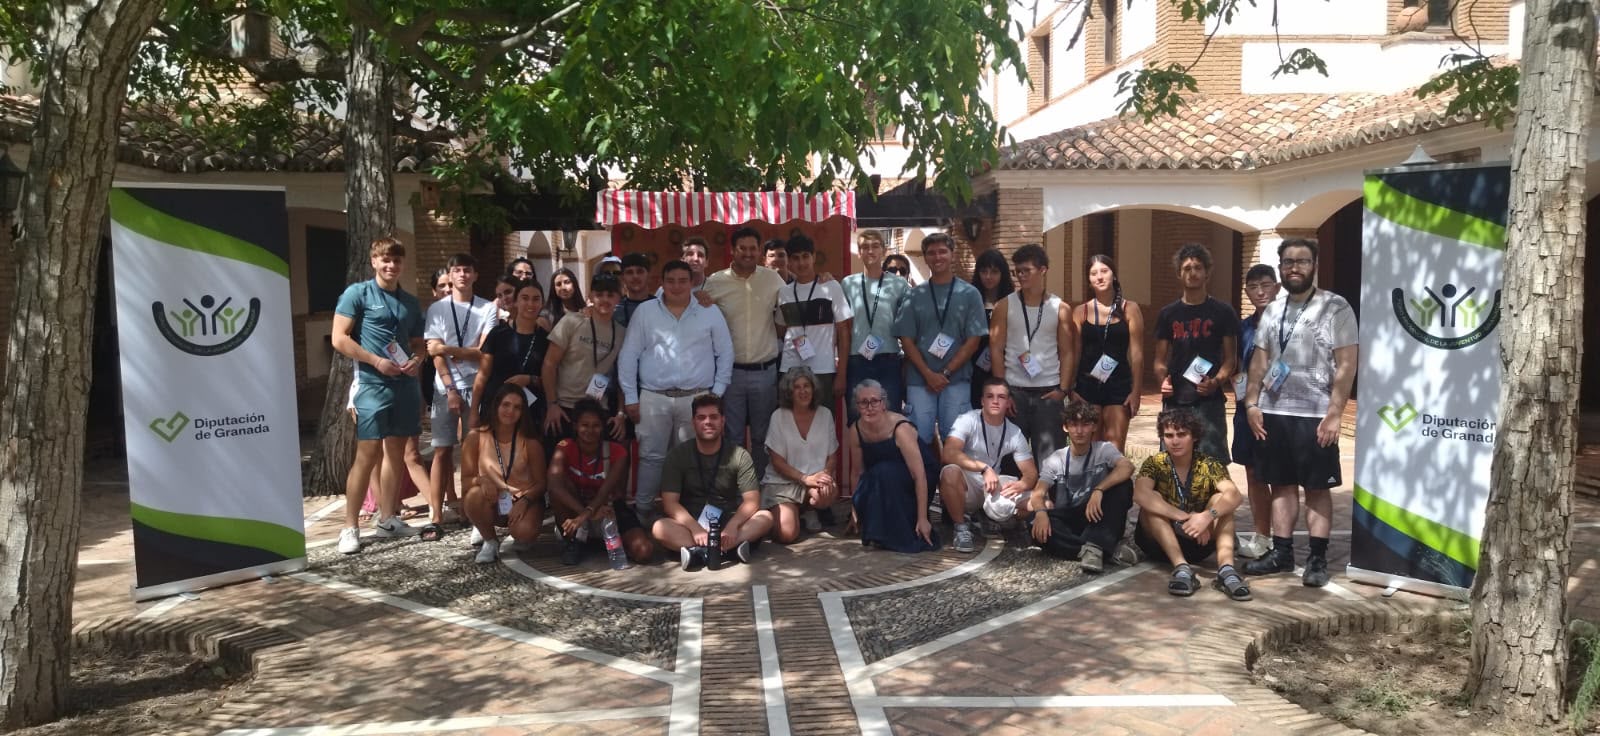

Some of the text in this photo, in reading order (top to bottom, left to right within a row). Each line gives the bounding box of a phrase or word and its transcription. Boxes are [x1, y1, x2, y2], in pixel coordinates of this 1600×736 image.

[194, 412, 265, 430] Diputación
[194, 423, 270, 441] de Granada
[1421, 427, 1495, 444] de Granad
